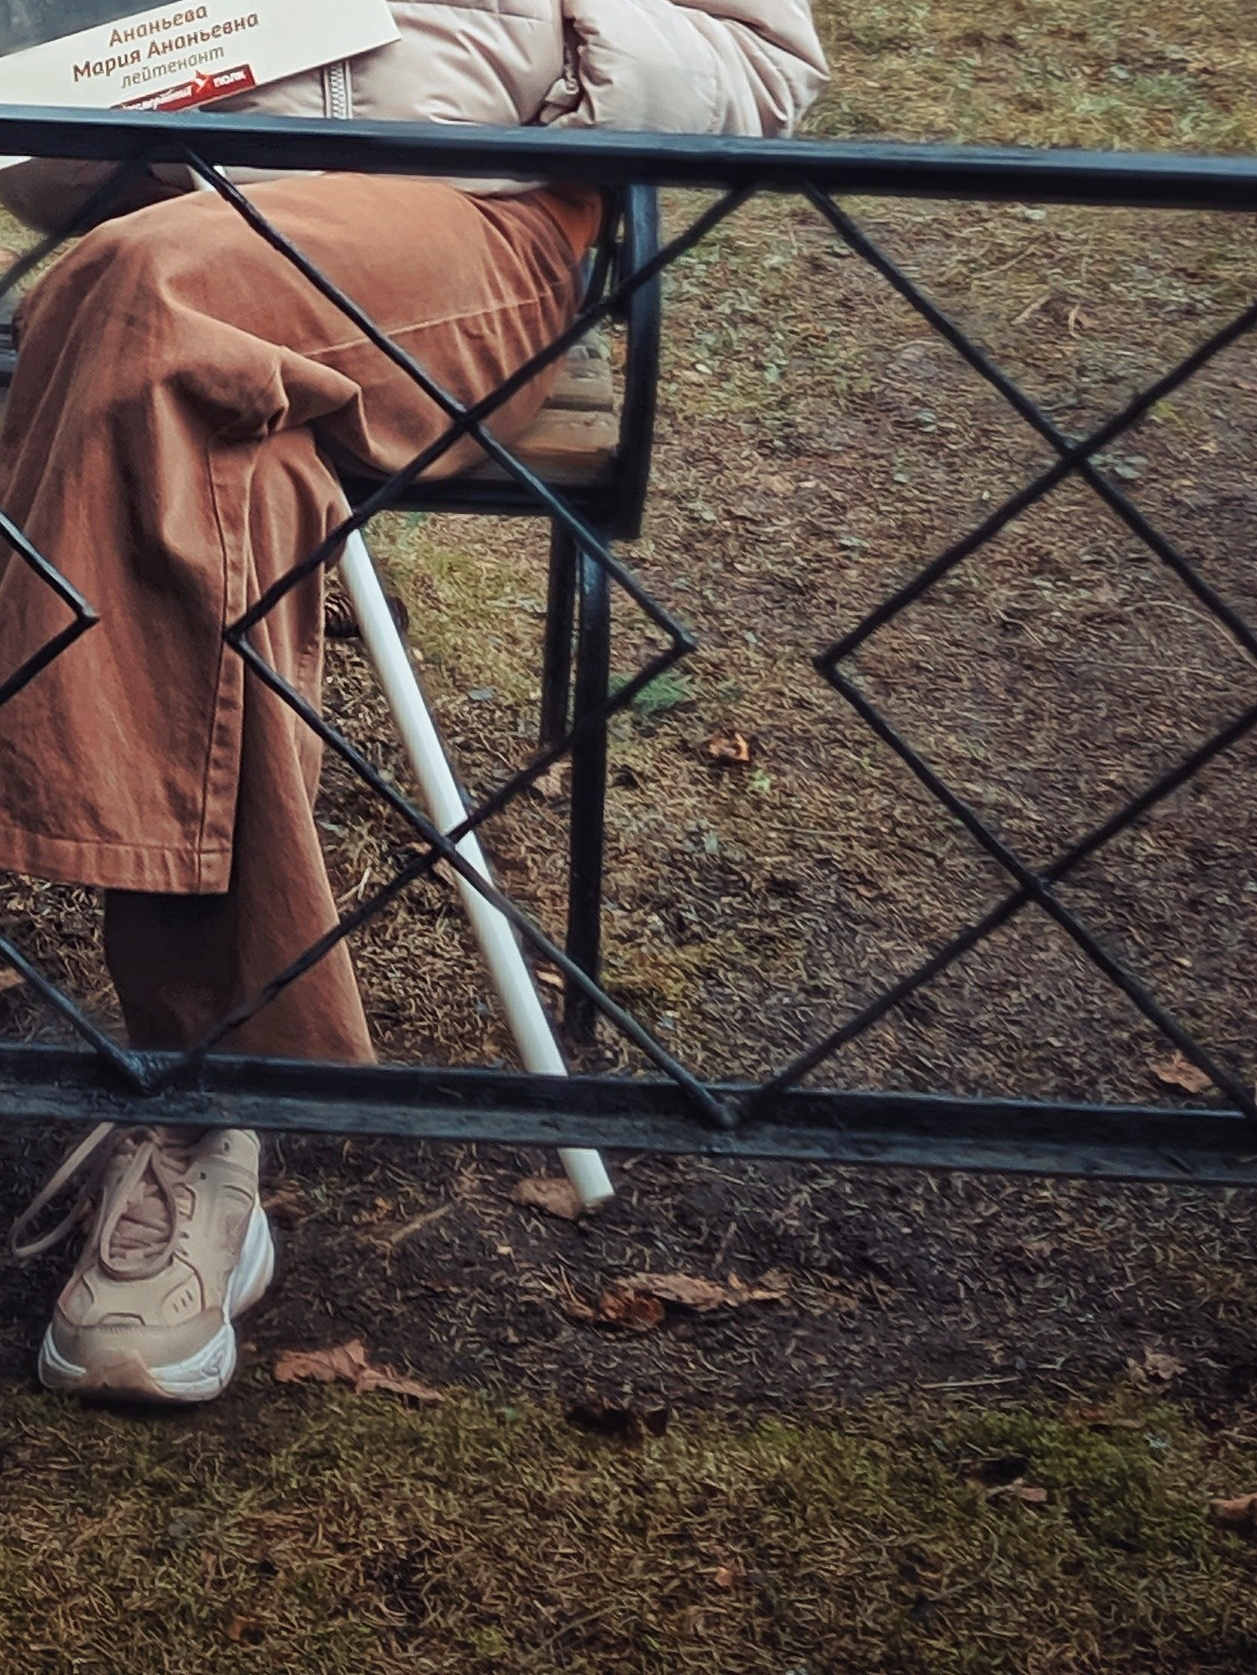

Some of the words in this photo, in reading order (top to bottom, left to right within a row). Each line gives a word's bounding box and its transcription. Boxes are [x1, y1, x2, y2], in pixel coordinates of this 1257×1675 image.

[73, 49, 141, 82] Мария
[147, 12, 259, 59] Ананьевна
[109, 5, 208, 47] Ананьева
[121, 45, 225, 89] лейтенант
